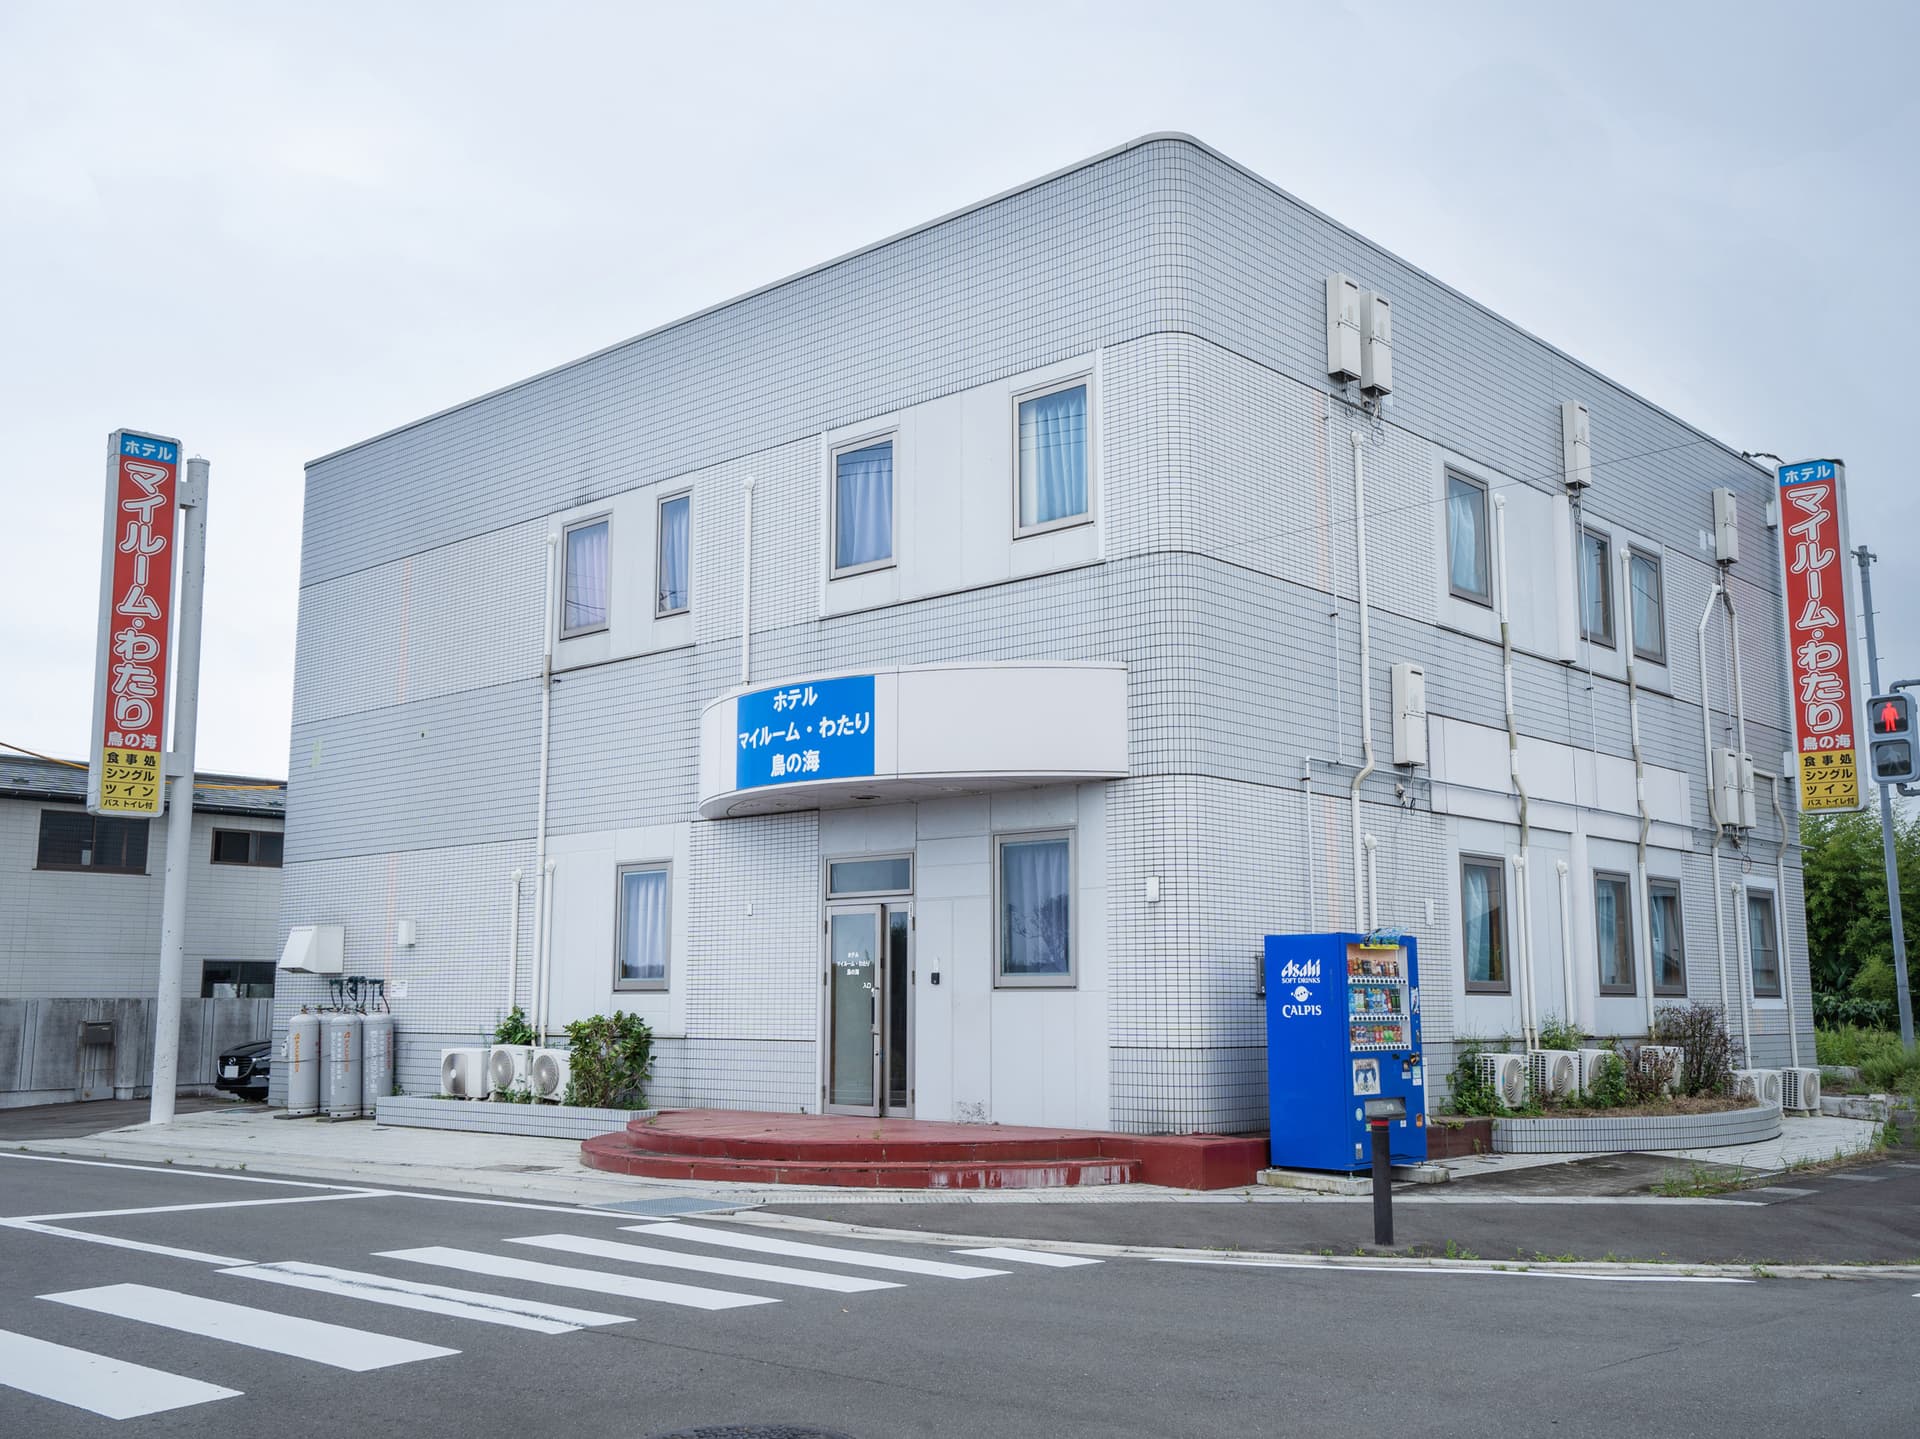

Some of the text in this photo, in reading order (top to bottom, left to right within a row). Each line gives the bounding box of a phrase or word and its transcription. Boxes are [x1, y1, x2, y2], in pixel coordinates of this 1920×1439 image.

[124, 440, 173, 461] ホテル
[1785, 465, 1831, 483] ホテル
[112, 461, 169, 730] マイルーム・わたり
[1786, 484, 1845, 734] マイルーム・わたり
[773, 686, 818, 712] ホテル
[738, 711, 870, 749] マイルーム・わたり
[107, 751, 156, 767] 食事処
[770, 749, 820, 777] 鳥の海
[1804, 754, 1852, 767] 食事処
[106, 767, 155, 782] シングル
[1805, 768, 1853, 781] シングル
[105, 784, 154, 798] ツイン
[1806, 783, 1854, 796] ツイン
[1281, 958, 1321, 978] Asahi
[1282, 1004, 1322, 1018] CALPIS
